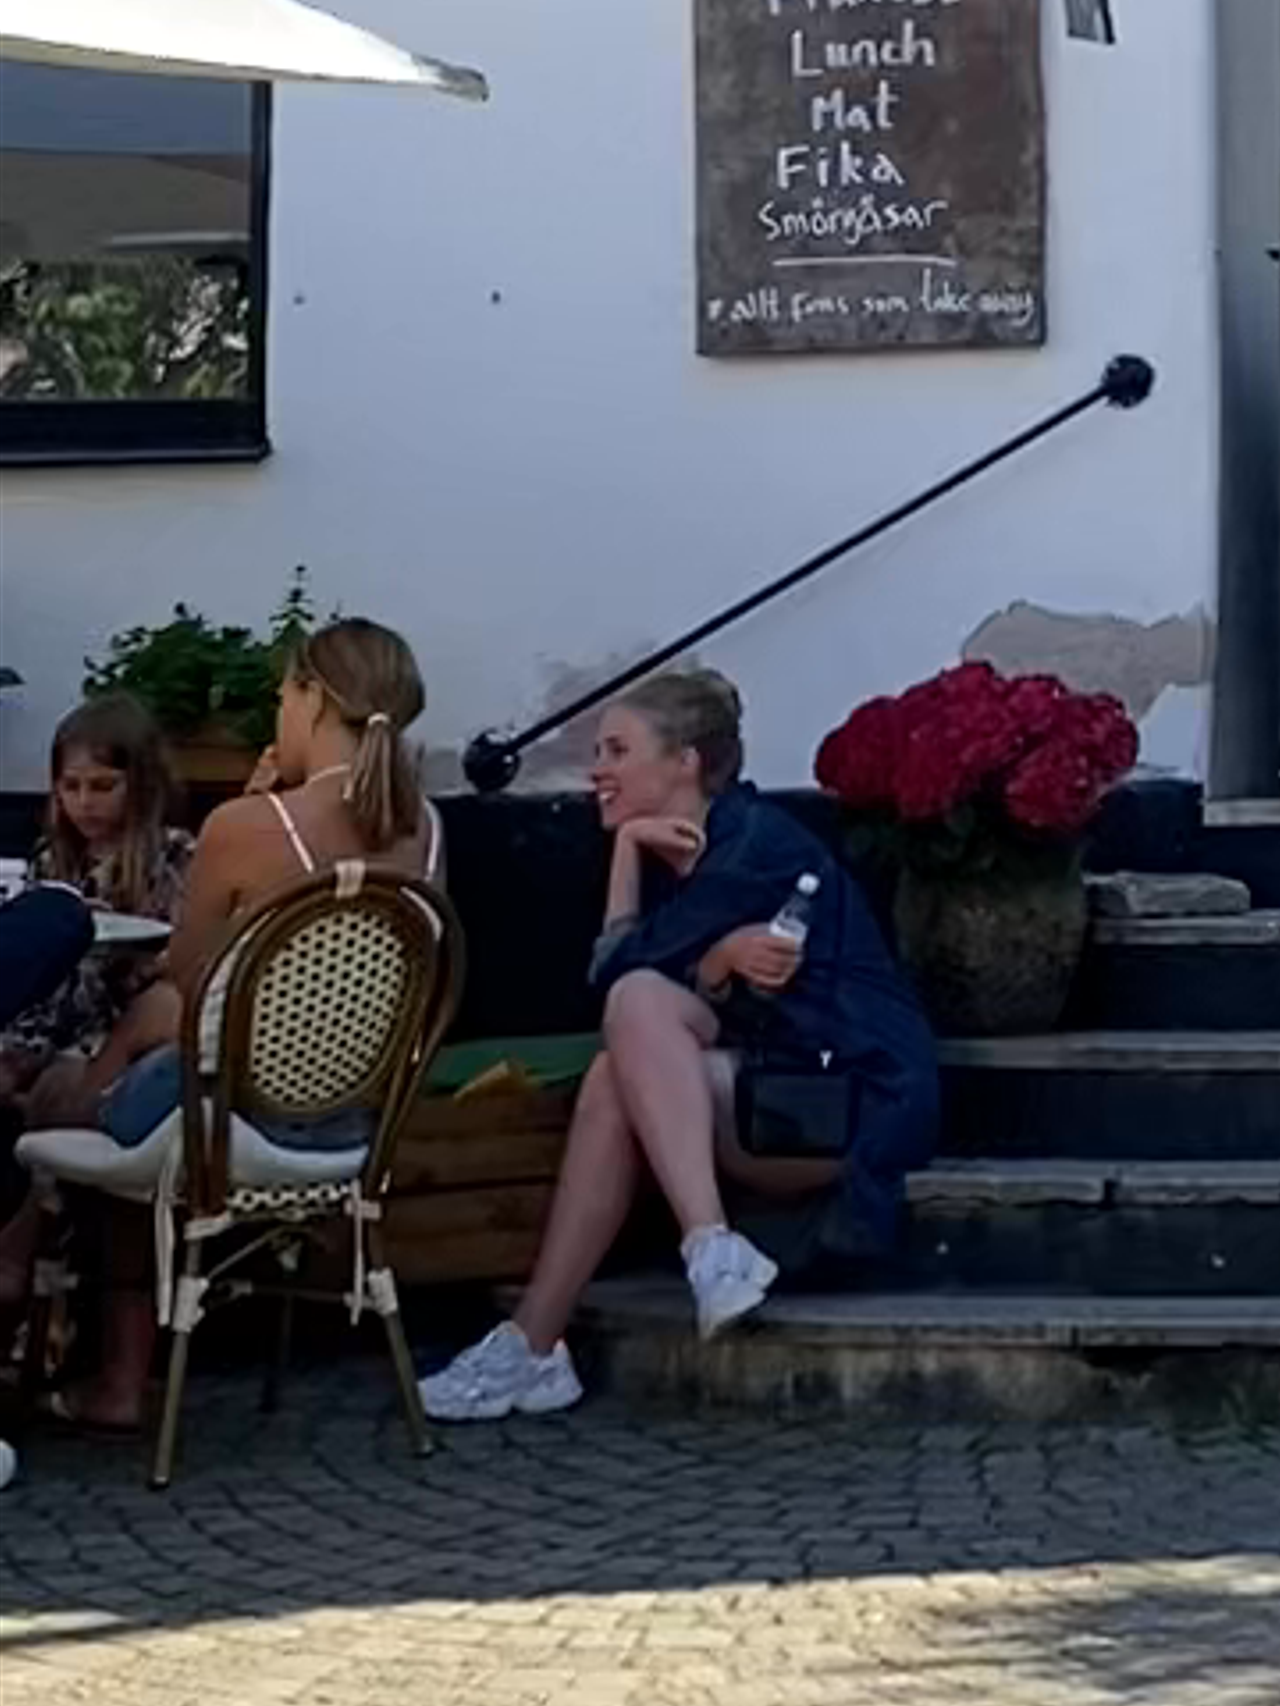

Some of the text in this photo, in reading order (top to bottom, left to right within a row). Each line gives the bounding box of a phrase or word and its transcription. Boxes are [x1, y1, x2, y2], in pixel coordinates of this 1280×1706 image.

[790, 18, 938, 78] Lunch
[810, 80, 902, 132] Mat
[775, 143, 905, 190] Fika
